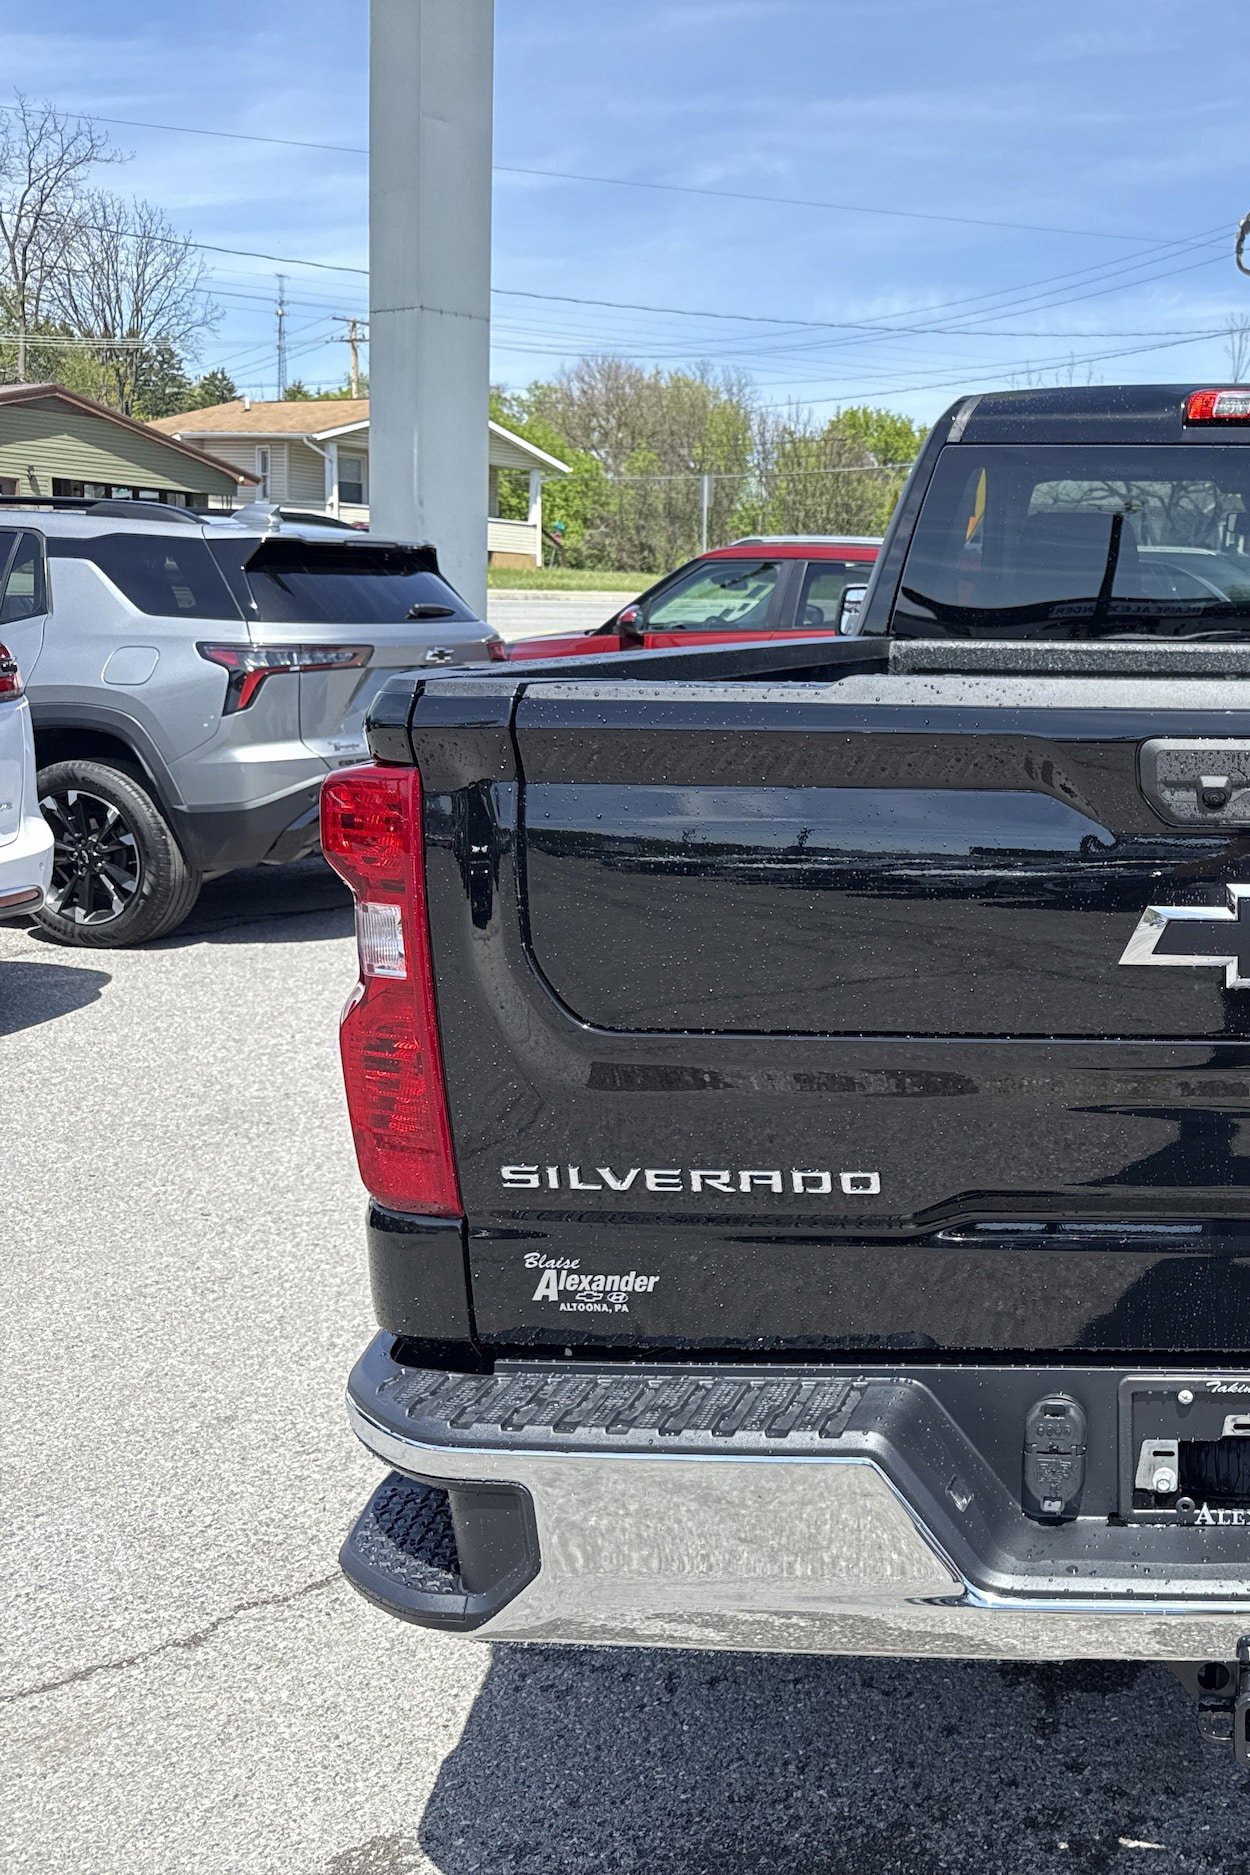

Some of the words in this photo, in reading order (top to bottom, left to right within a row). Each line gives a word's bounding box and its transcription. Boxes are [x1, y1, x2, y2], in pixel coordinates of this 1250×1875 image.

[500, 1163, 881, 1196] SILVERADO
[523, 1252, 580, 1269] Blaise
[532, 1269, 660, 1302] Alexander
[559, 1303, 612, 1313] ALTOONA,
[614, 1303, 629, 1312] PA
